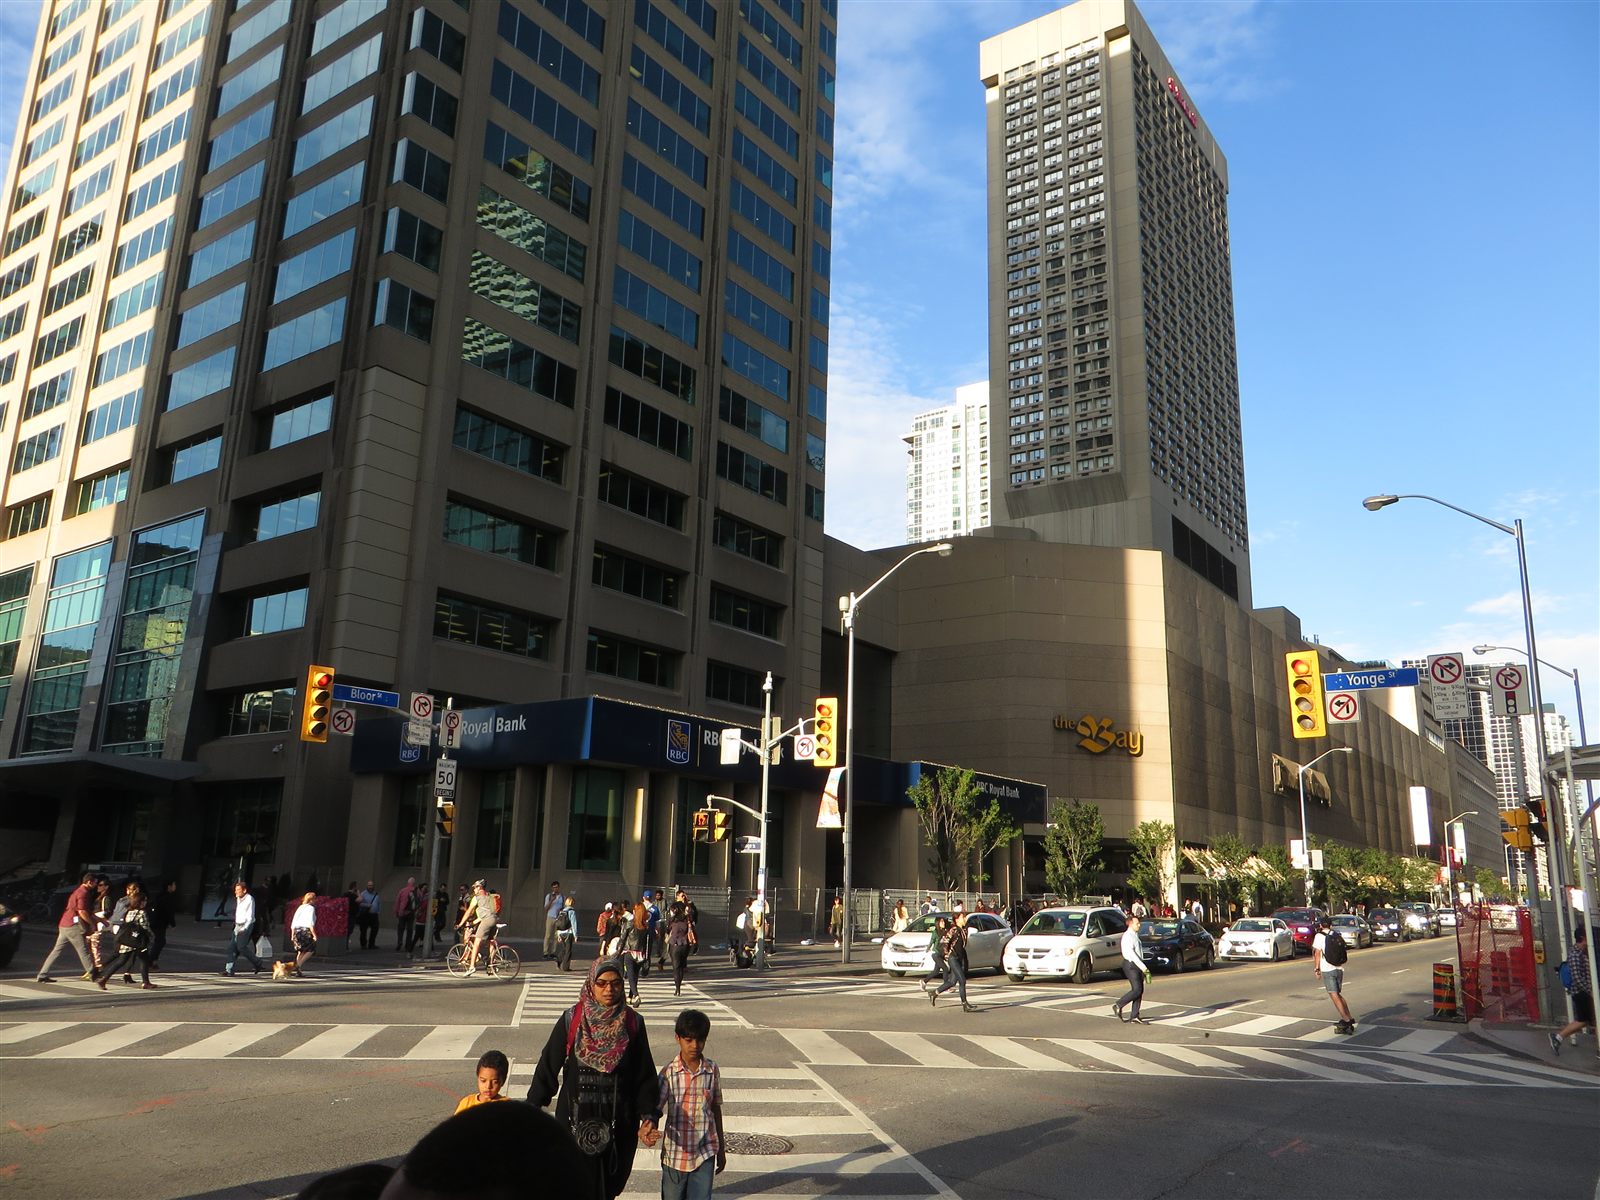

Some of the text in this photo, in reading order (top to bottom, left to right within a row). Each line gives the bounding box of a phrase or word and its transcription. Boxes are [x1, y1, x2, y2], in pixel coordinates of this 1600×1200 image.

[1346, 674, 1385, 687] Yonge
[350, 688, 376, 701] Bloor
[461, 714, 527, 737] Royal Bank
[704, 729, 722, 746] RB
[1054, 713, 1142, 756] the Bay
[402, 749, 418, 759] RBC
[670, 749, 687, 761] RBC
[437, 771, 454, 785] 50
[989, 783, 1005, 797] Royal
[1006, 786, 1020, 798] Bank
